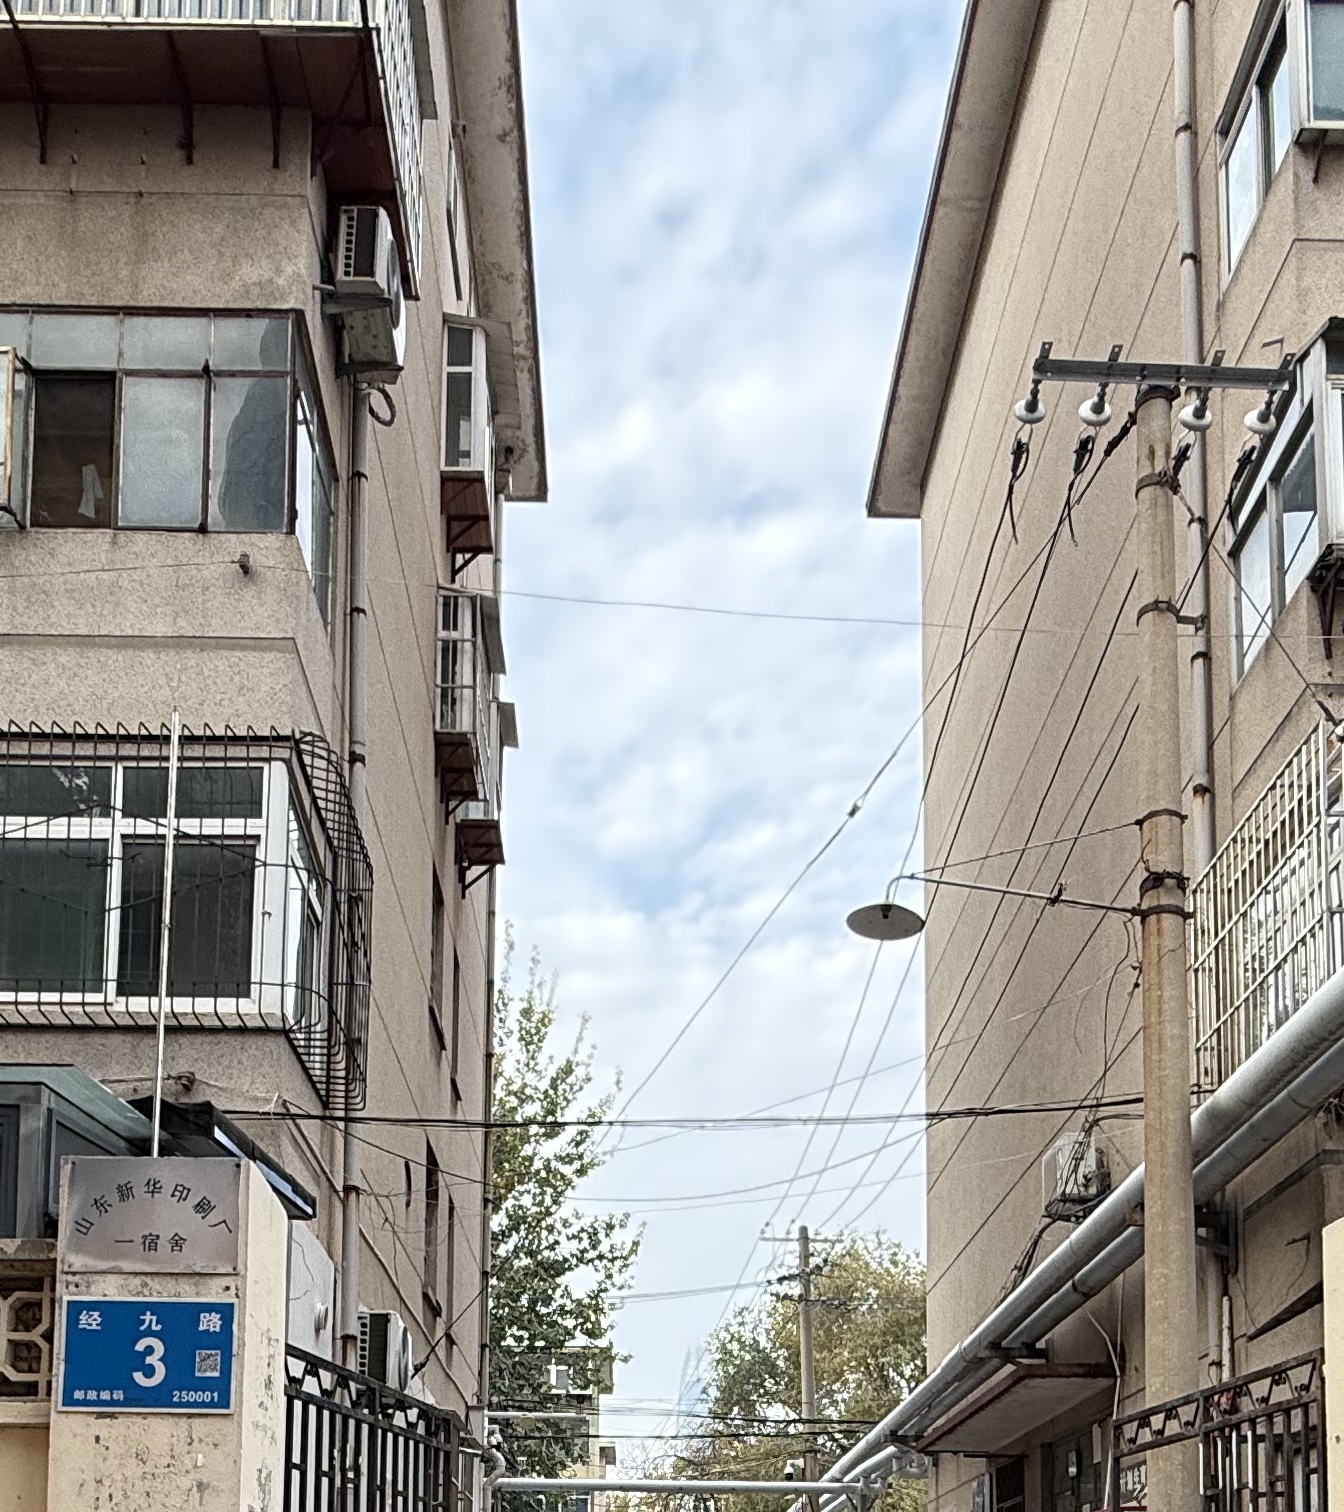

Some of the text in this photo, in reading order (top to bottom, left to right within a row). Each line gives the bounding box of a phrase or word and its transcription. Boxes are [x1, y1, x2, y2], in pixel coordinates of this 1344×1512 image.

[74, 1177, 233, 1236] 山东新华印刷厂
[114, 1232, 187, 1253] 一宿舍
[78, 1310, 222, 1333] 经九路
[132, 1336, 166, 1388] 3
[73, 1389, 219, 1403] 邮政编码 250001
